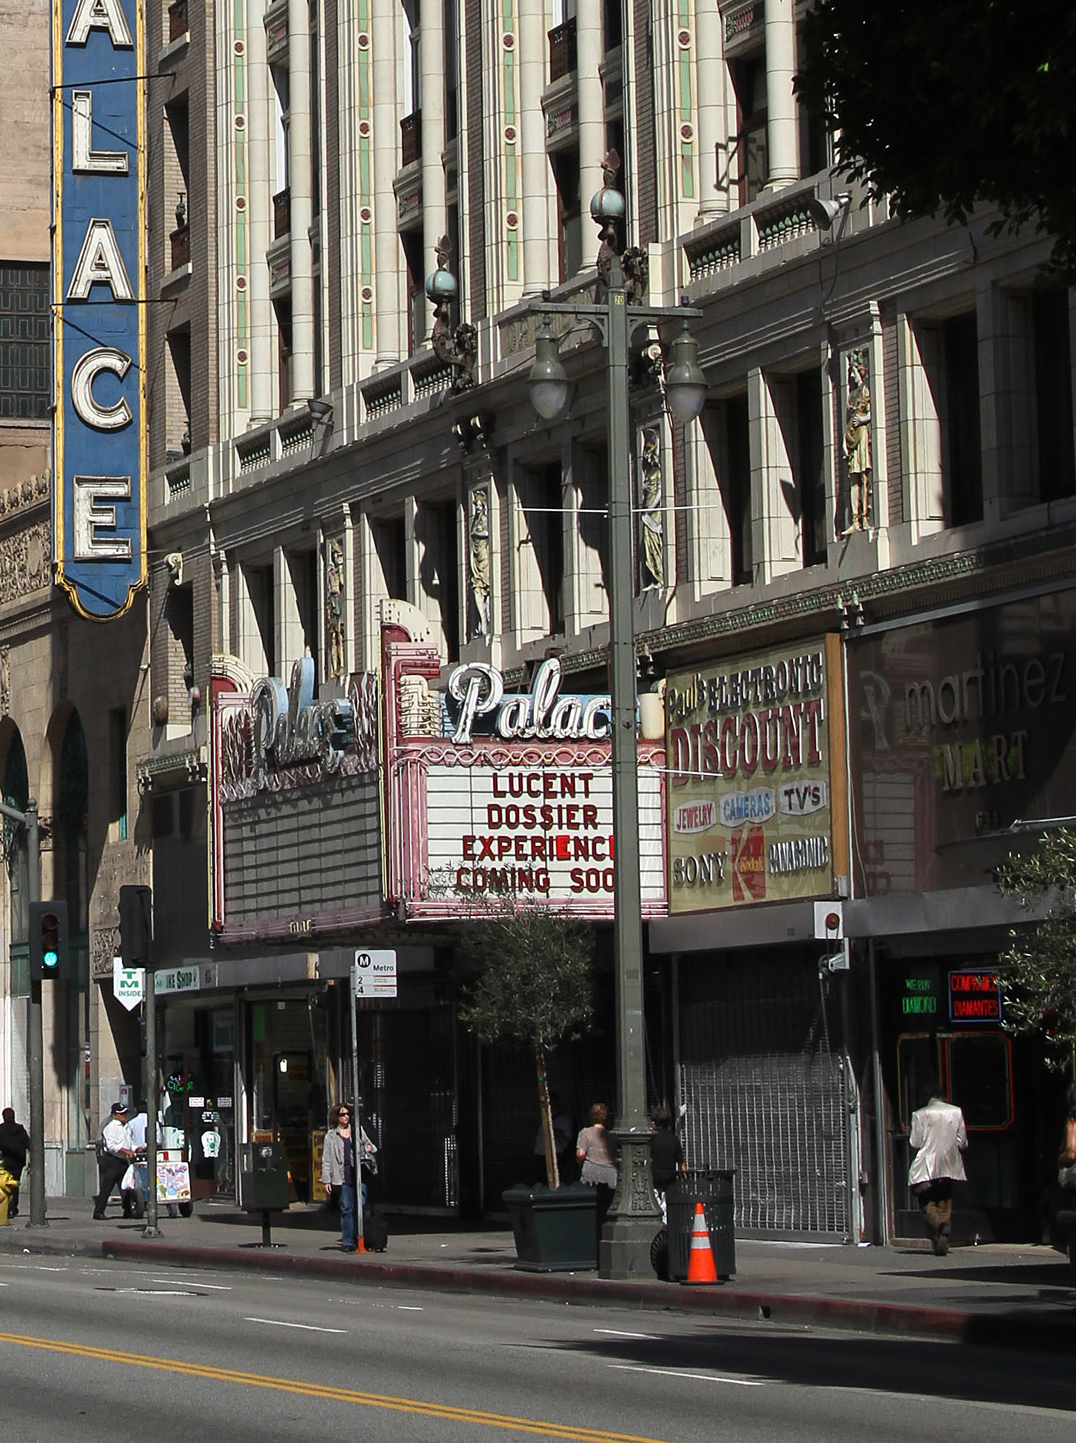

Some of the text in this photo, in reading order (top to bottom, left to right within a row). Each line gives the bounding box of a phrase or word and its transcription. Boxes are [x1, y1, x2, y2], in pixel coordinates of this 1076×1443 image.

[448, 658, 612, 745] Palac
[668, 652, 823, 724] Paul's ELECTRONIC
[905, 651, 1067, 726] martinez
[671, 698, 824, 787] DISCOUNT
[942, 729, 1029, 792] MART
[493, 772, 594, 798] LUCENT
[784, 786, 821, 810] TV'S
[487, 804, 598, 830] DOSSIER
[677, 803, 713, 830] JEWELRY
[723, 793, 772, 821] CAMERAS
[462, 835, 615, 862] EXPERIENC
[768, 836, 829, 874] PANASONIC
[674, 851, 728, 885] SONY
[740, 857, 764, 872] Kodak
[457, 867, 615, 894] COMING SOO
[357, 976, 363, 985] 2
[373, 964, 394, 972] Metro
[357, 986, 364, 994] 4
[954, 999, 999, 1017] DIAMANTES
